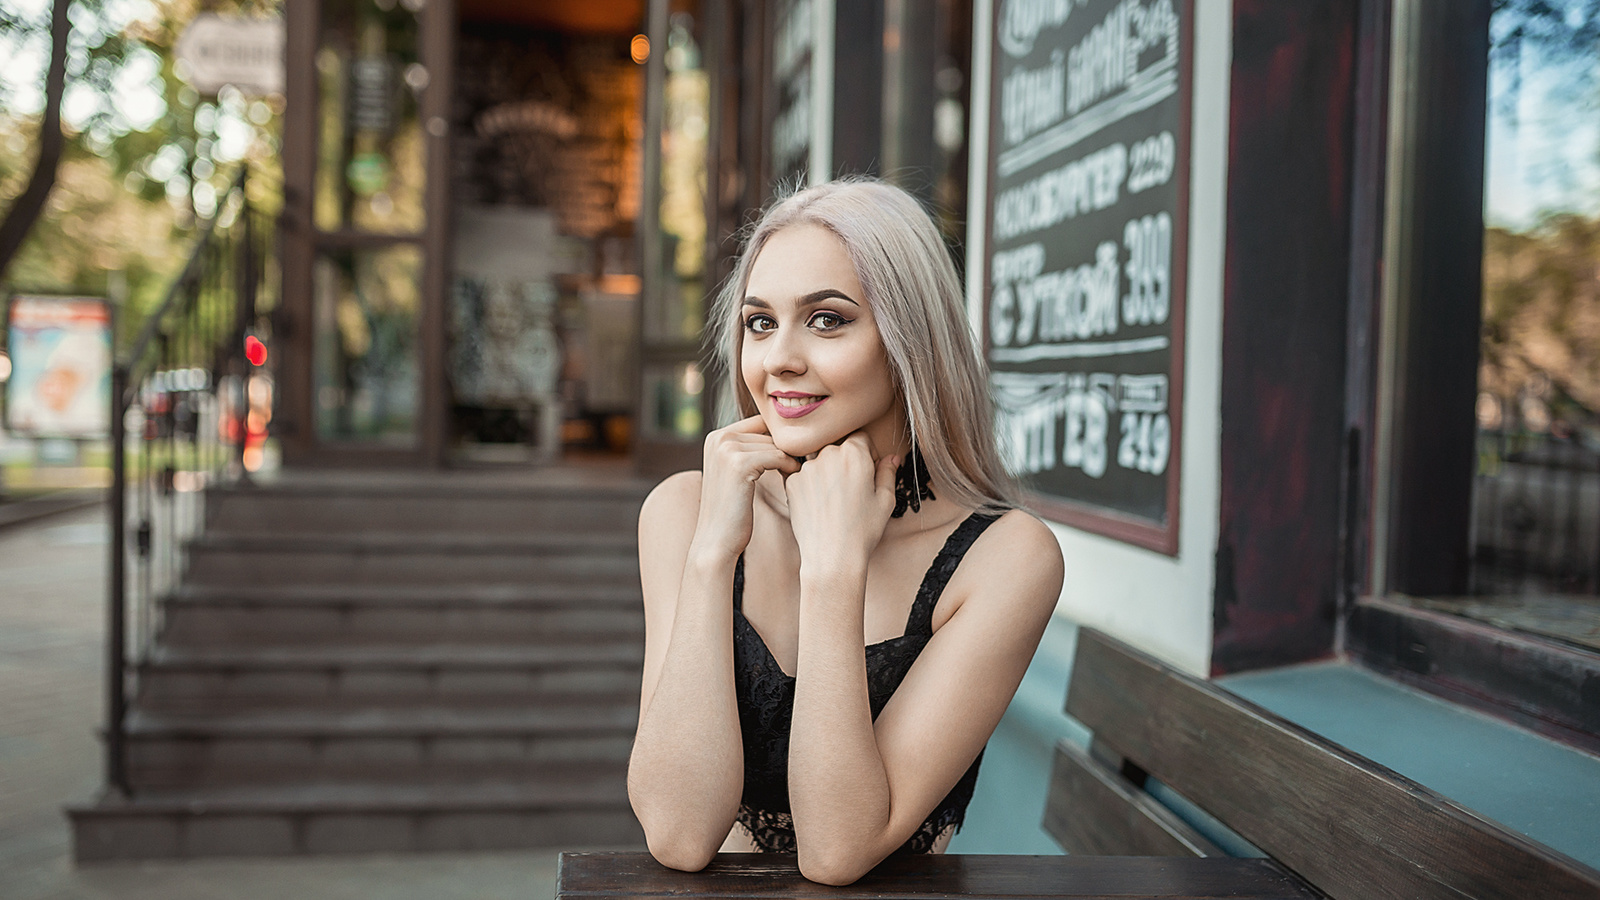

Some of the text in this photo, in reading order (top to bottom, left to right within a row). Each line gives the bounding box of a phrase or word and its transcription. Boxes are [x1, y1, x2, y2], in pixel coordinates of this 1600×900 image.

[1128, 130, 1176, 194] 229
[989, 283, 1014, 346] С
[1016, 240, 1119, 346] УТКОЙ
